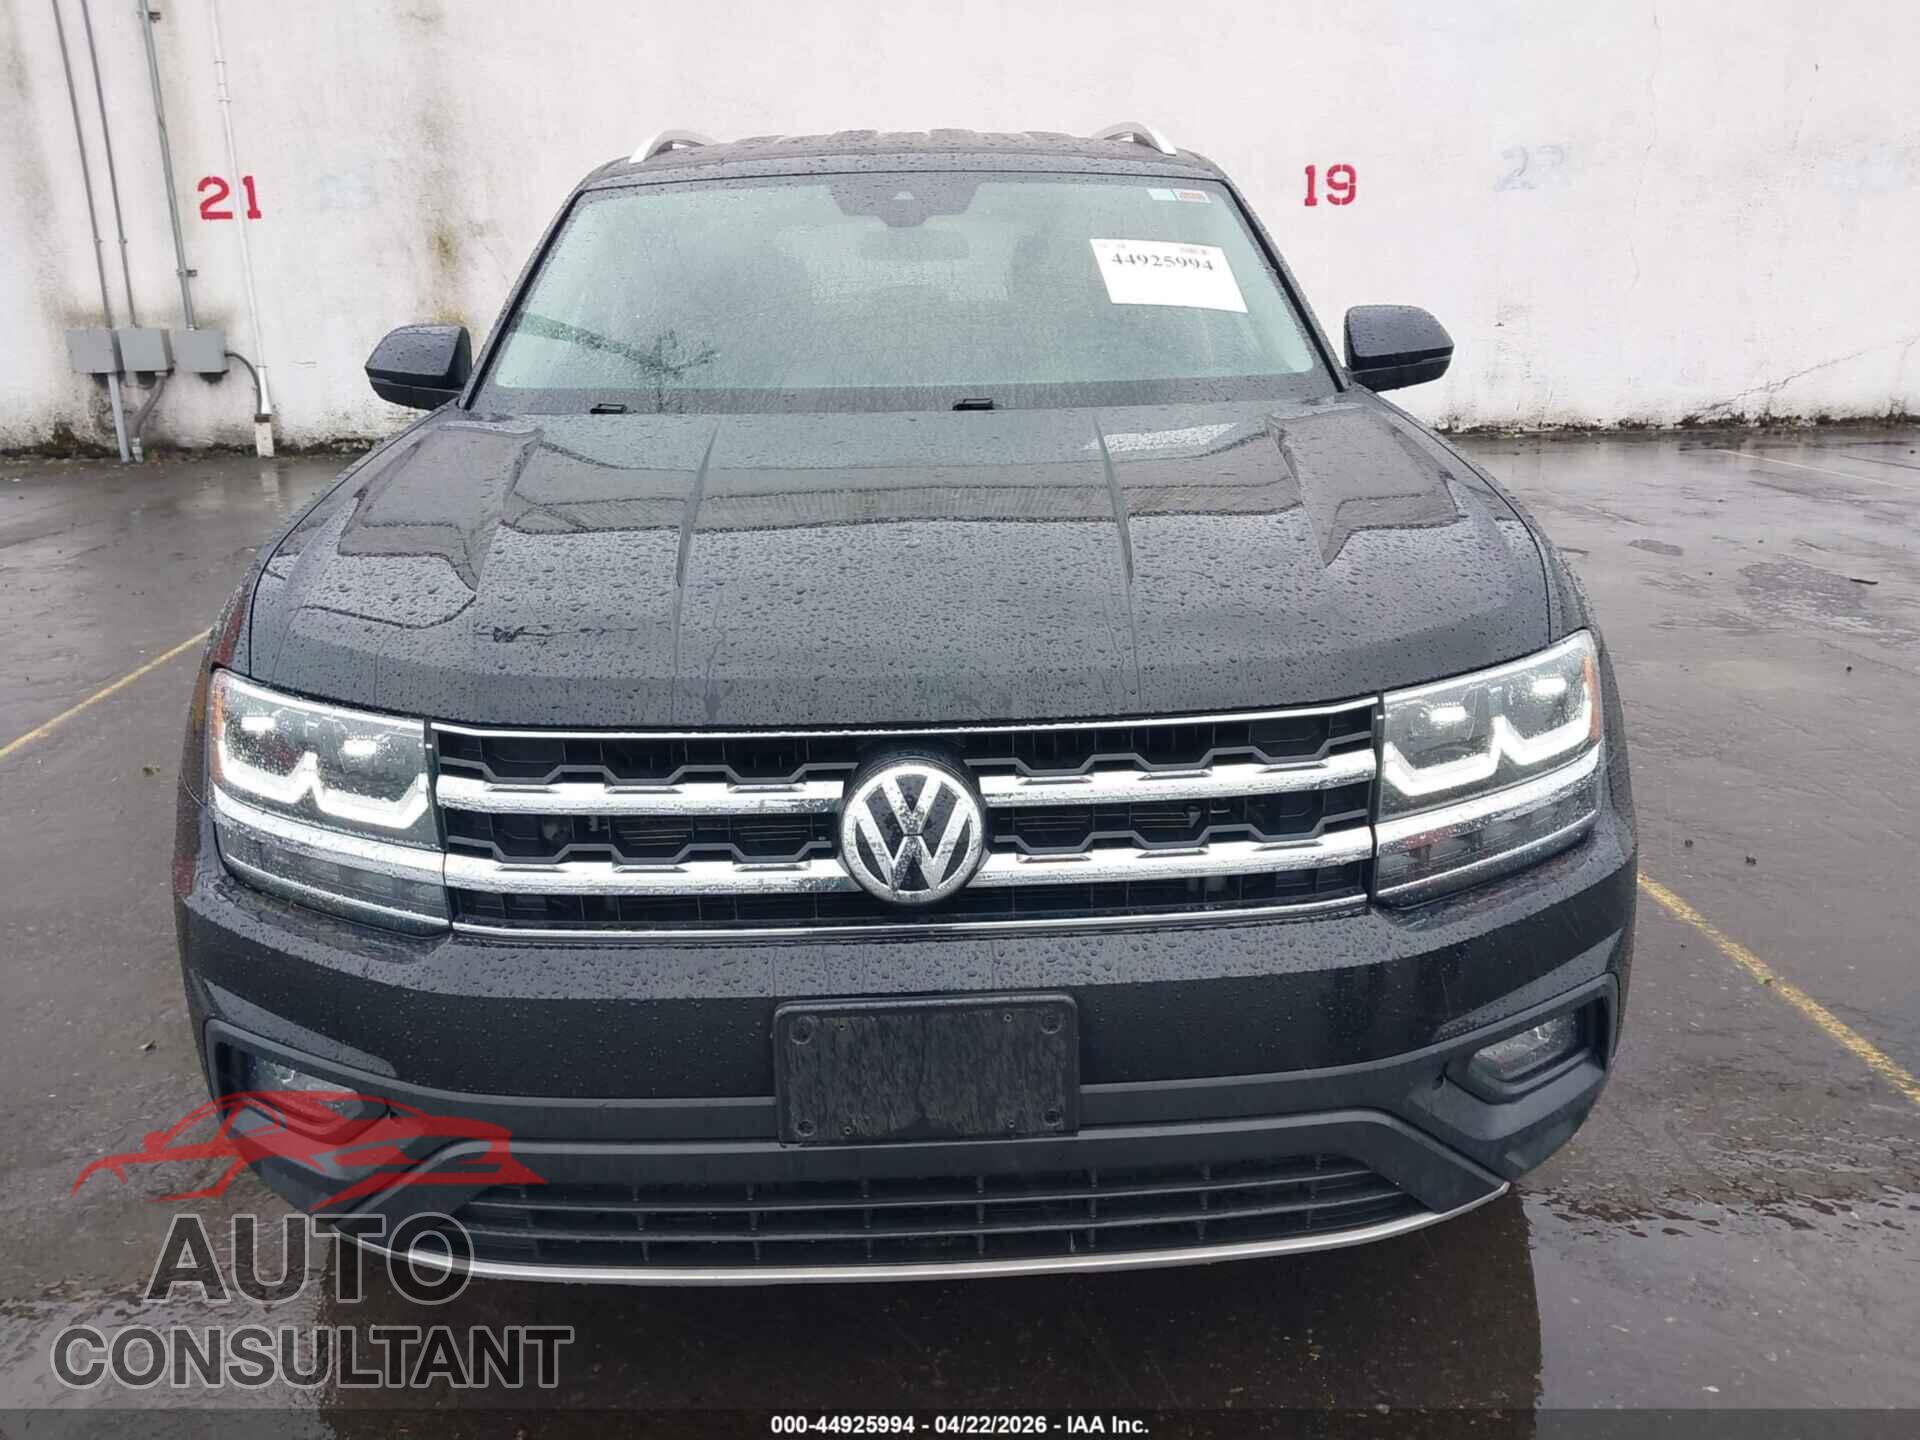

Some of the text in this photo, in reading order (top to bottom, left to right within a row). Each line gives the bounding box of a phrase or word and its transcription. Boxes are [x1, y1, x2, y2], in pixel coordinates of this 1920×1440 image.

[197, 175, 262, 220] 21
[1303, 163, 1357, 206] 19
[1111, 252, 1215, 272] 44925994
